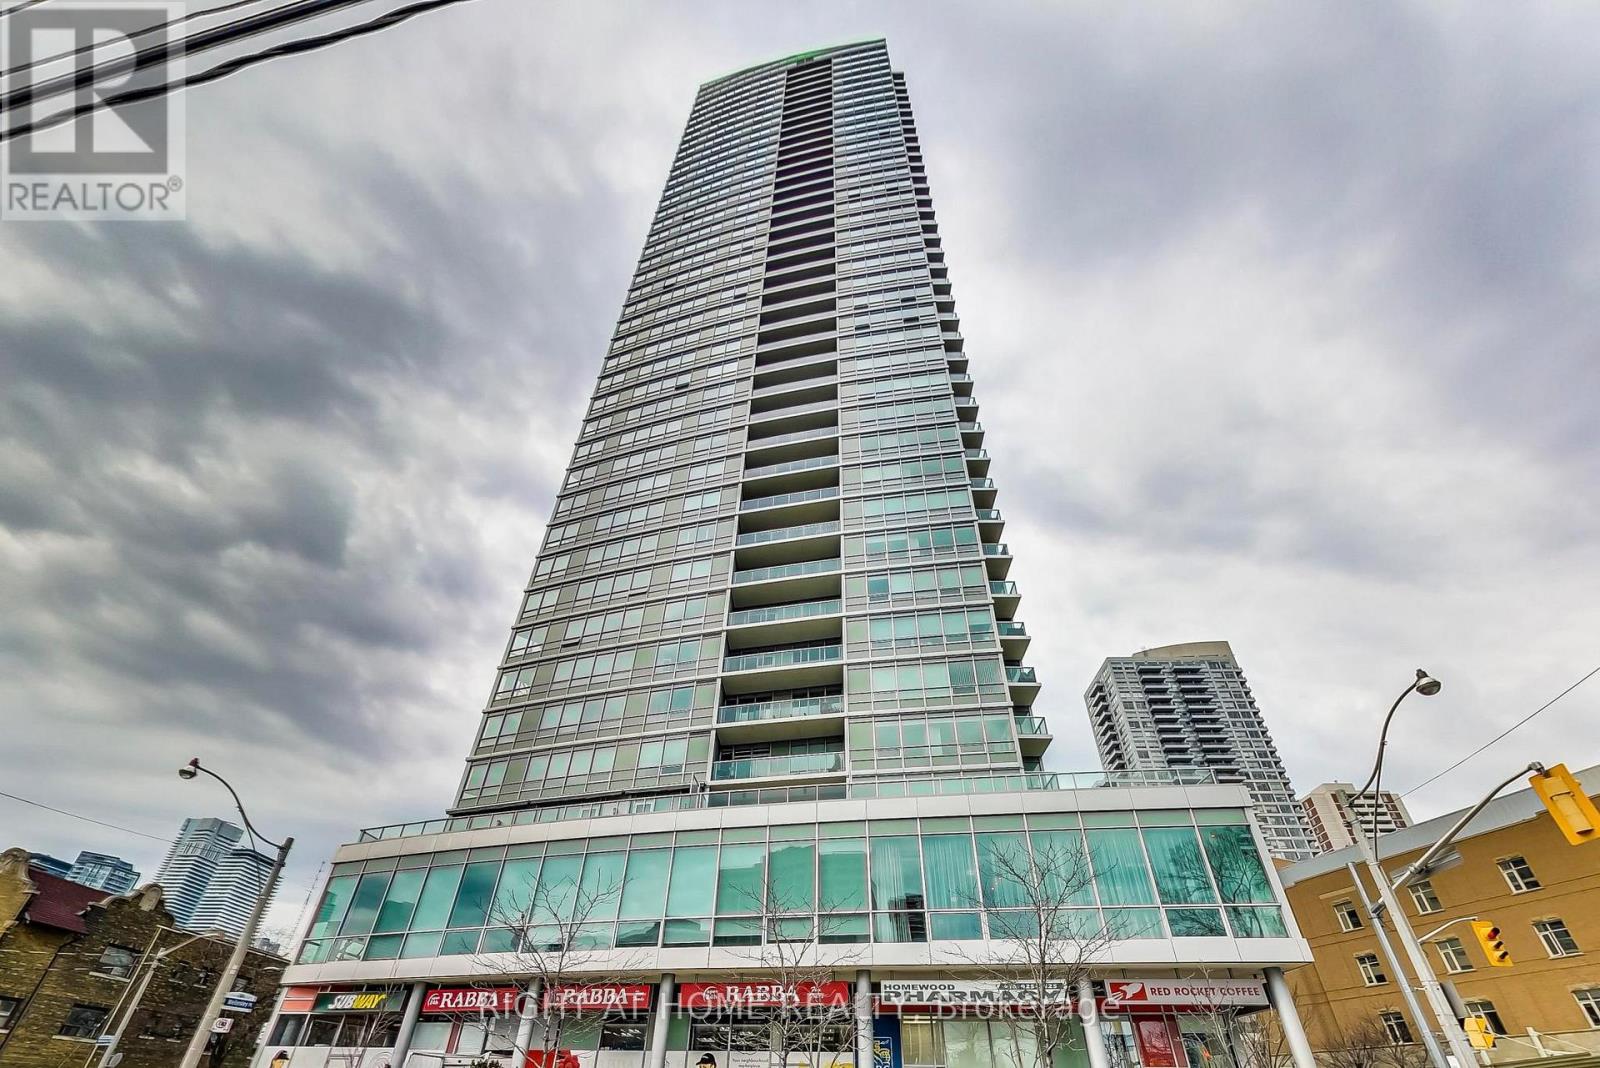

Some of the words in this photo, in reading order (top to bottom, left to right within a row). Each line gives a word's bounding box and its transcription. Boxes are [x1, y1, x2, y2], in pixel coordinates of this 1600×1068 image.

[439, 990, 498, 1008] RABBA
[562, 987, 628, 1005] RABBA
[725, 985, 800, 1003] RABBA
[883, 990, 1061, 1003] PHARMACY
[1150, 987, 1171, 996] RED
[1174, 987, 1216, 996] ROCKET
[1220, 987, 1260, 996] COFFEE
[328, 993, 387, 1009] SUBWAY
